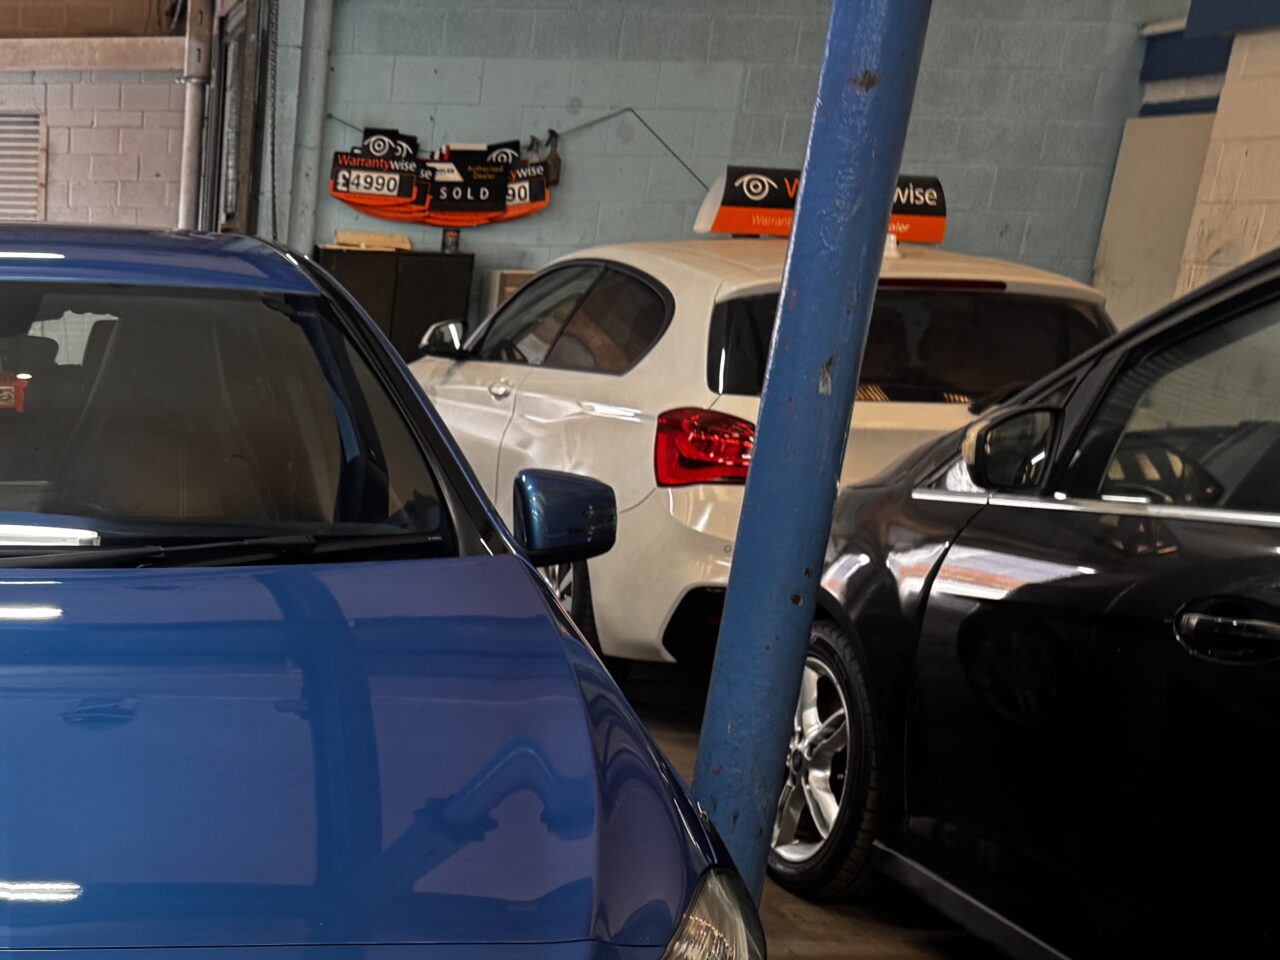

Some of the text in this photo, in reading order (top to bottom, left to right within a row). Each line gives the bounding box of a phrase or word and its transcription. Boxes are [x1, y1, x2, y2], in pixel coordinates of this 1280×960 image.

[337, 154, 417, 172] Warrantywise
[336, 170, 398, 193] £4990
[510, 164, 545, 181] ywise
[439, 186, 490, 200] SOLD
[506, 184, 528, 203] 90
[892, 182, 938, 206] wise
[751, 213, 793, 227] Warrant
